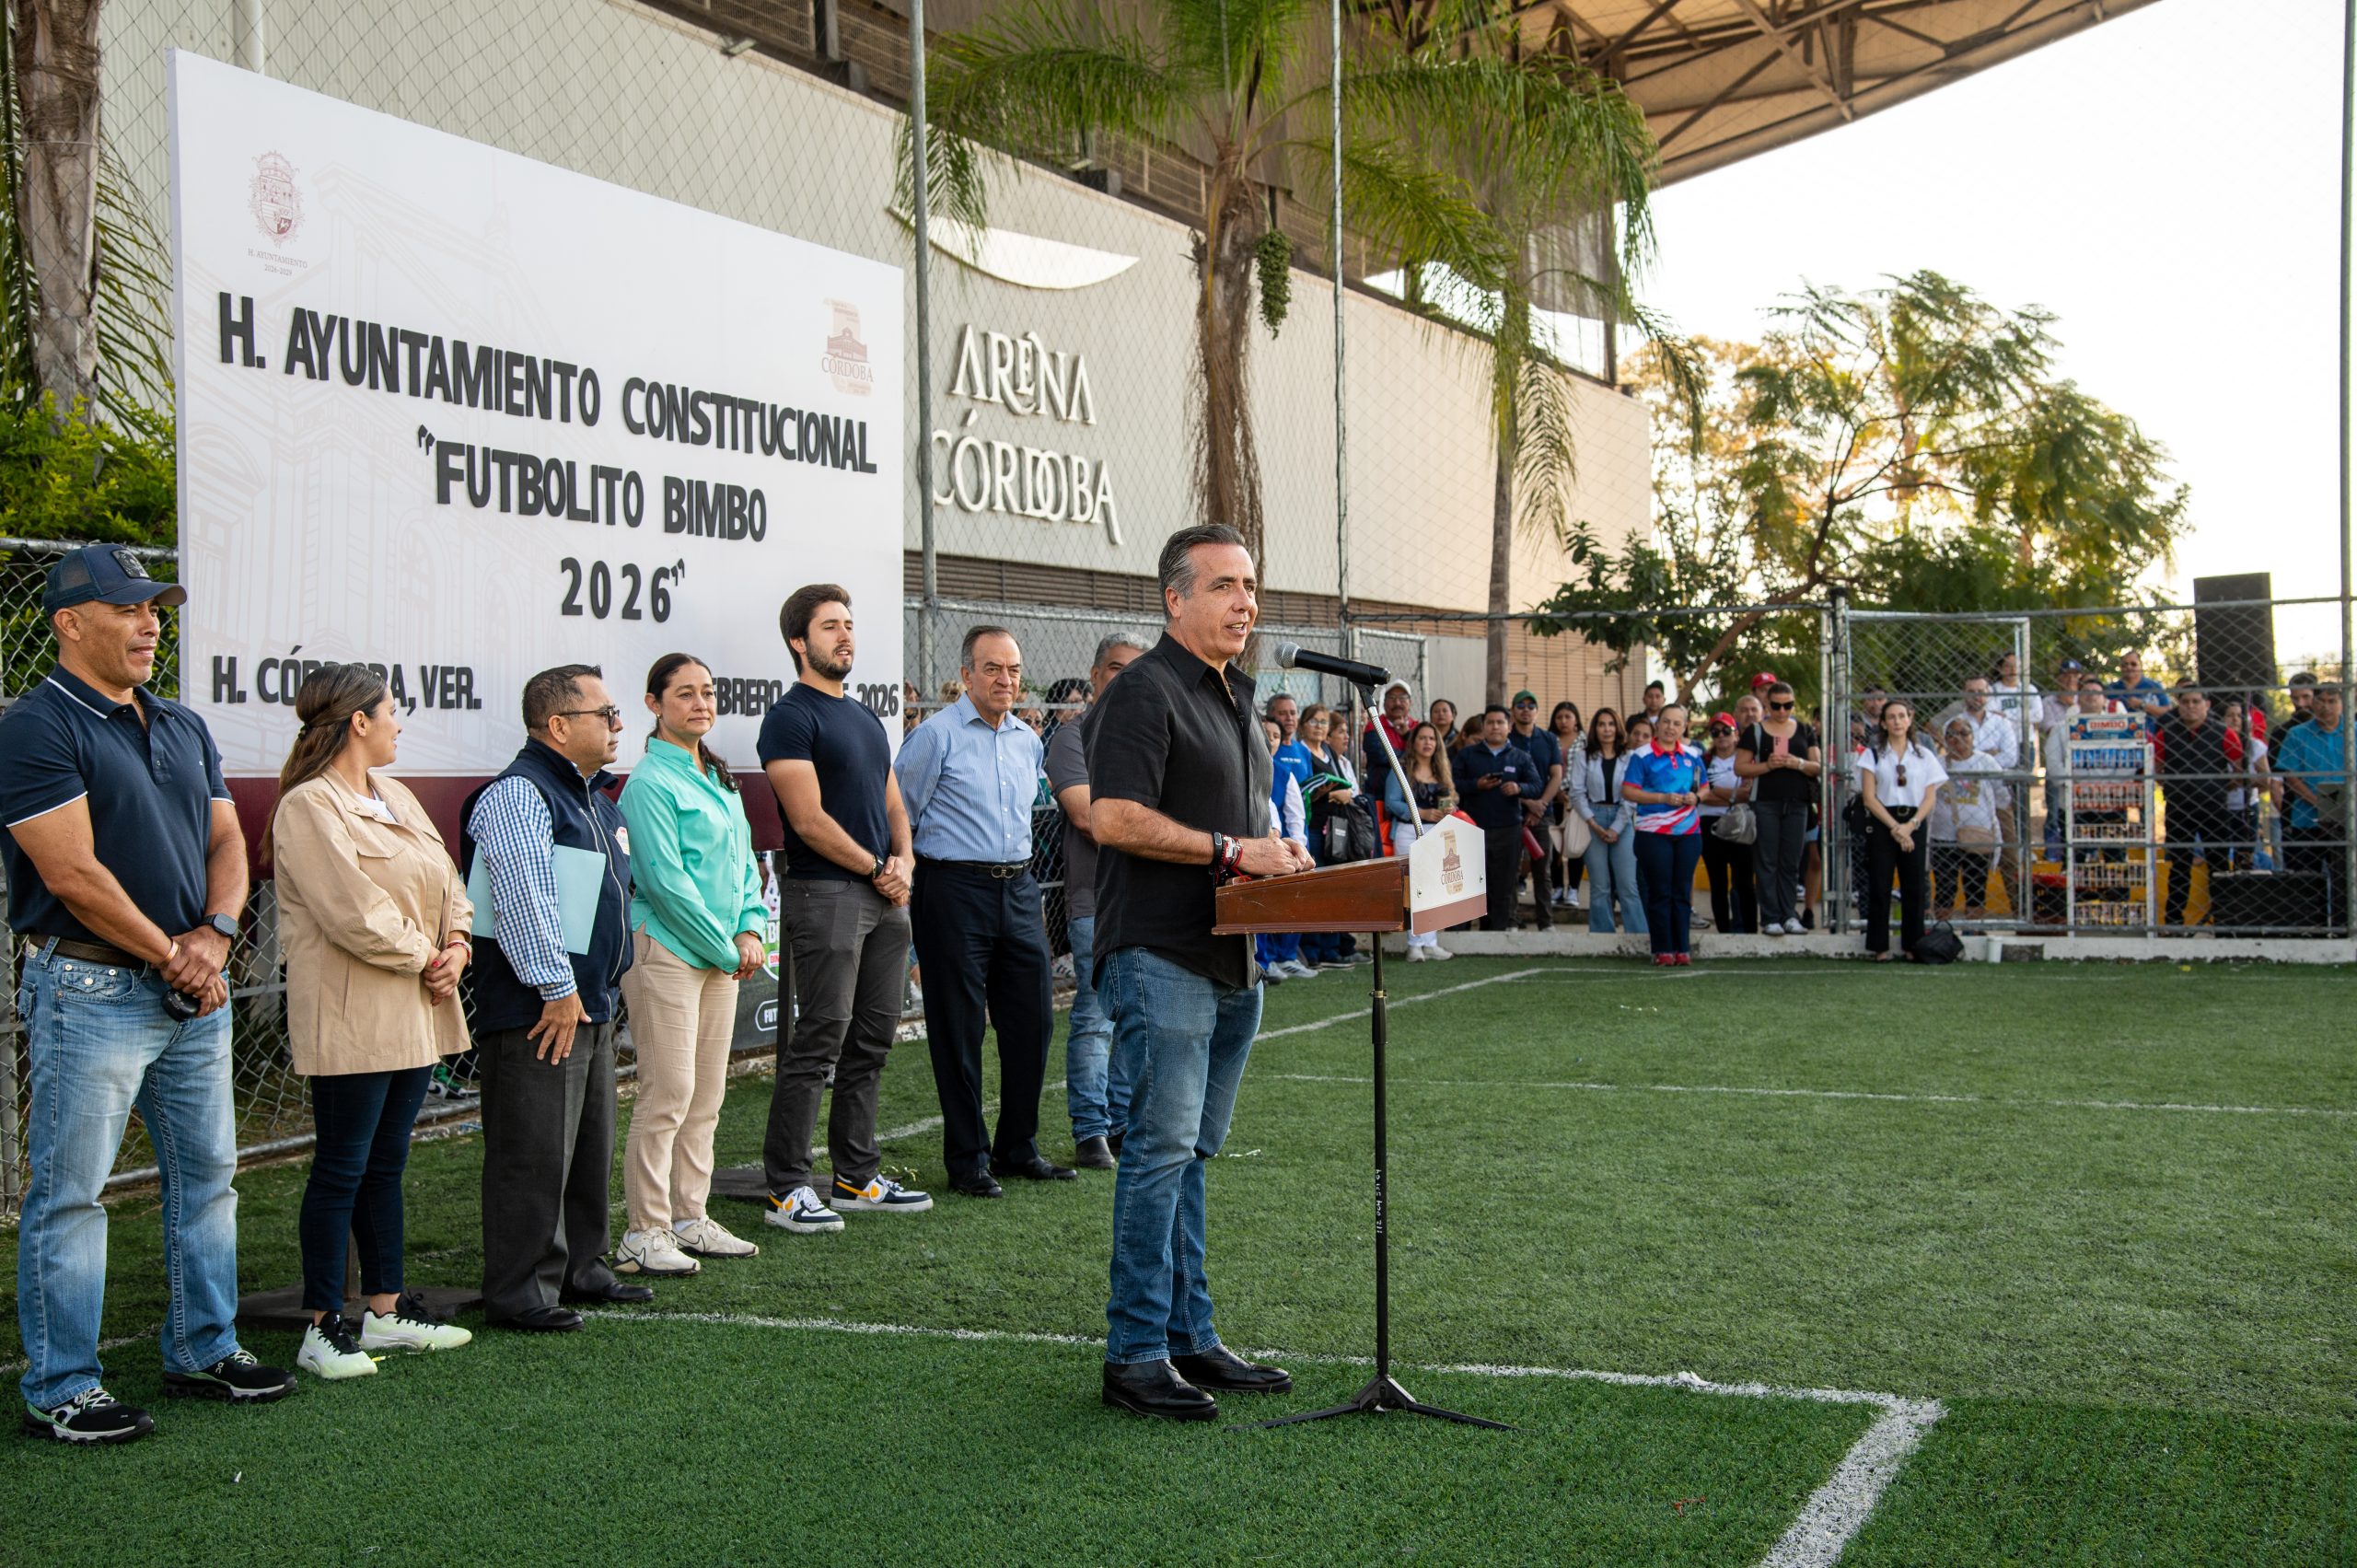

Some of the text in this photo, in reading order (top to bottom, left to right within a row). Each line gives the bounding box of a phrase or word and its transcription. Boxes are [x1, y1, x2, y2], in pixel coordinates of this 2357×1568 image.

[257, 250, 308, 269] AYUNTAMIENTO
[219, 291, 878, 474] H. AYUNTAMIENTO CONSTITUCIONAL
[664, 475, 768, 542] BIMBO
[213, 655, 247, 704] H.
[421, 665, 482, 710] VER.
